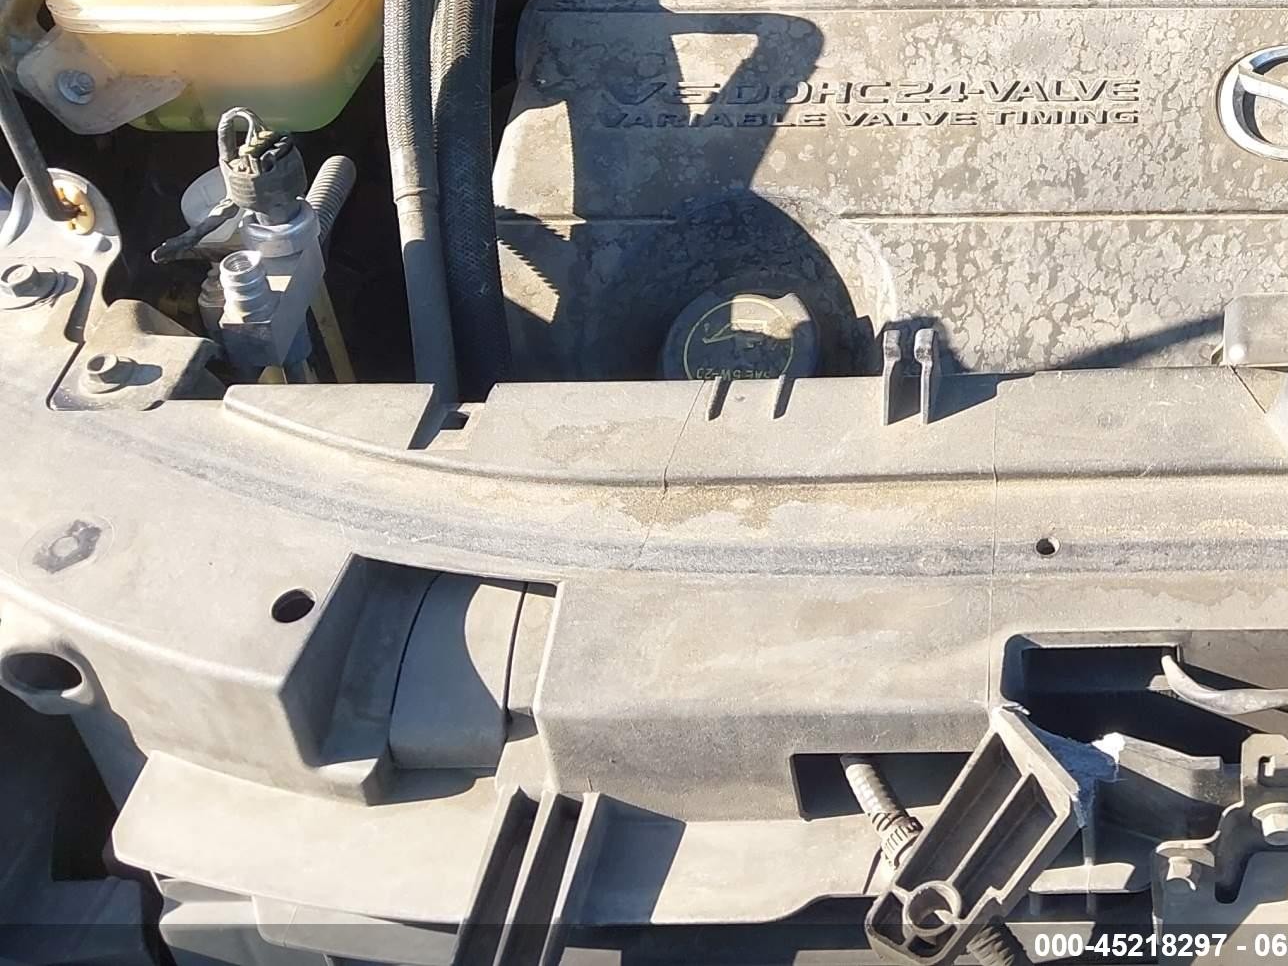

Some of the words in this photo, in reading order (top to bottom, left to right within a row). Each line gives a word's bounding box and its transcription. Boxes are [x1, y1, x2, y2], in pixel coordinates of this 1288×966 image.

[600, 79, 721, 106] V6
[724, 79, 892, 106] DOHC
[896, 78, 1141, 104] 24-VALVE
[603, 111, 827, 128] VARIABLE
[842, 110, 978, 127] VALVE
[988, 108, 1139, 126] TIMING
